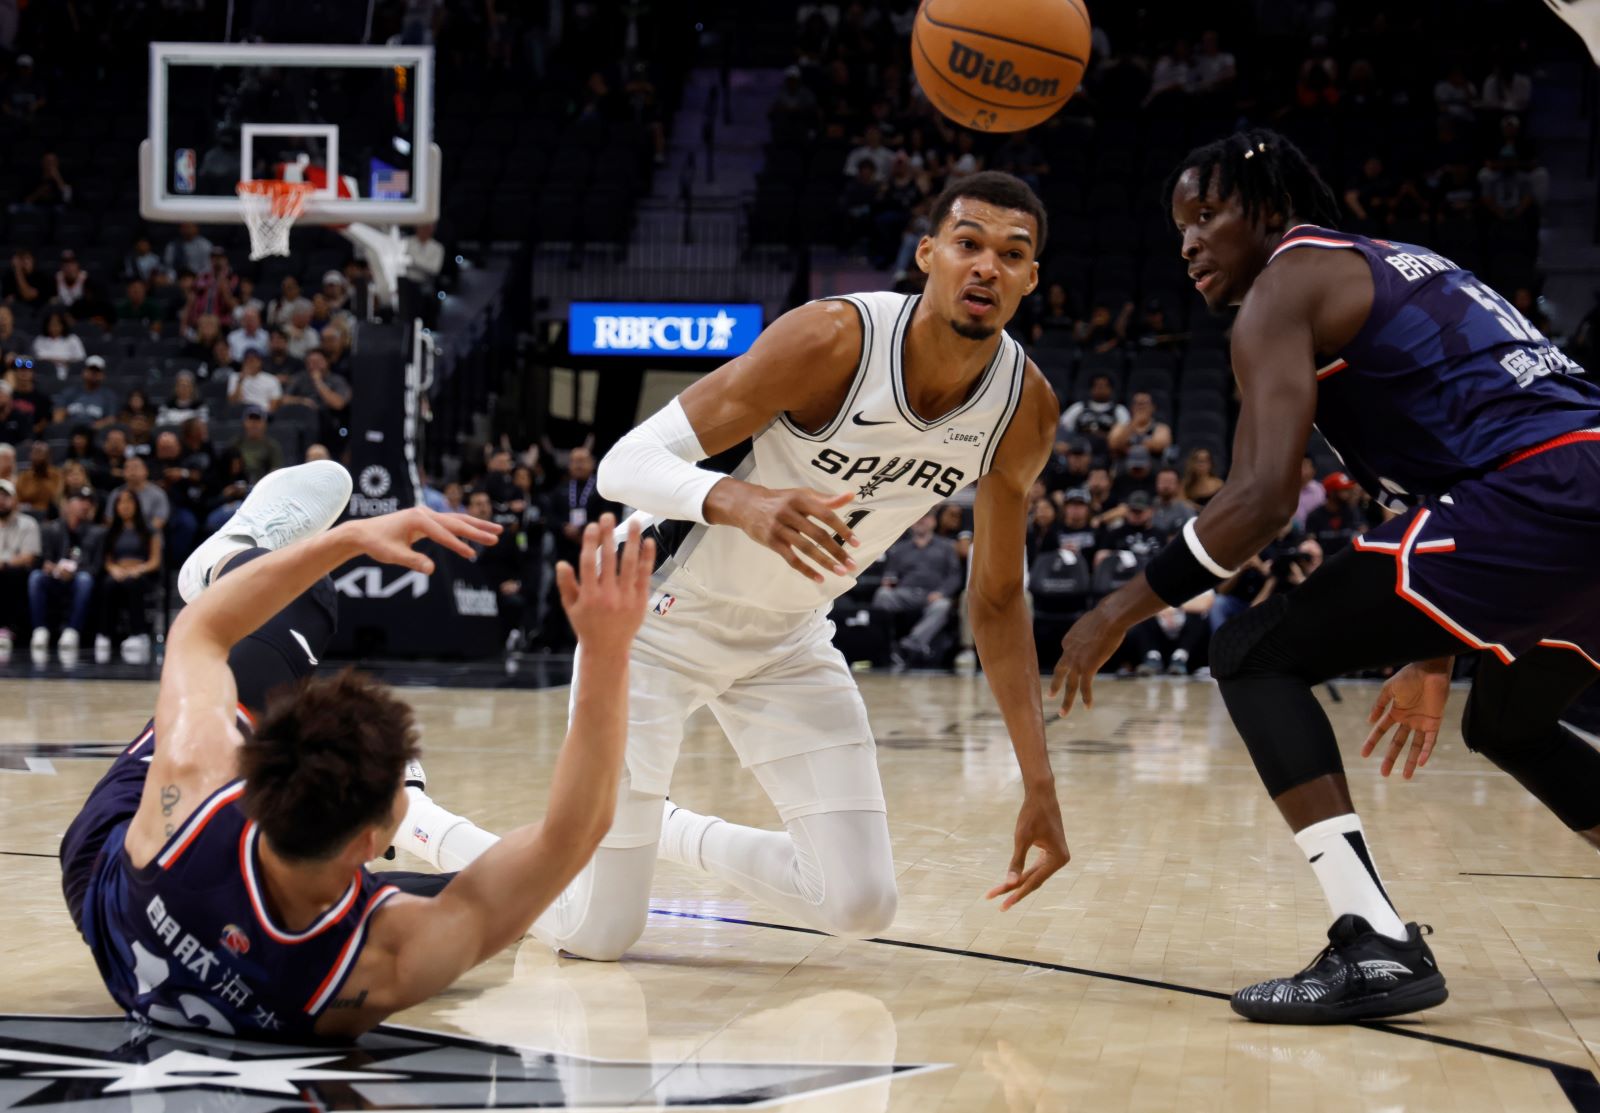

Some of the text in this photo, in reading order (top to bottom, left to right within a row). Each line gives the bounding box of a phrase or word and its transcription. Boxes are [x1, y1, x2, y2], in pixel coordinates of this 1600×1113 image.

[949, 41, 1061, 97] Wilson
[593, 315, 714, 351] RBFCU
[949, 432, 979, 443] LEDGER
[811, 448, 965, 499] SPURS
